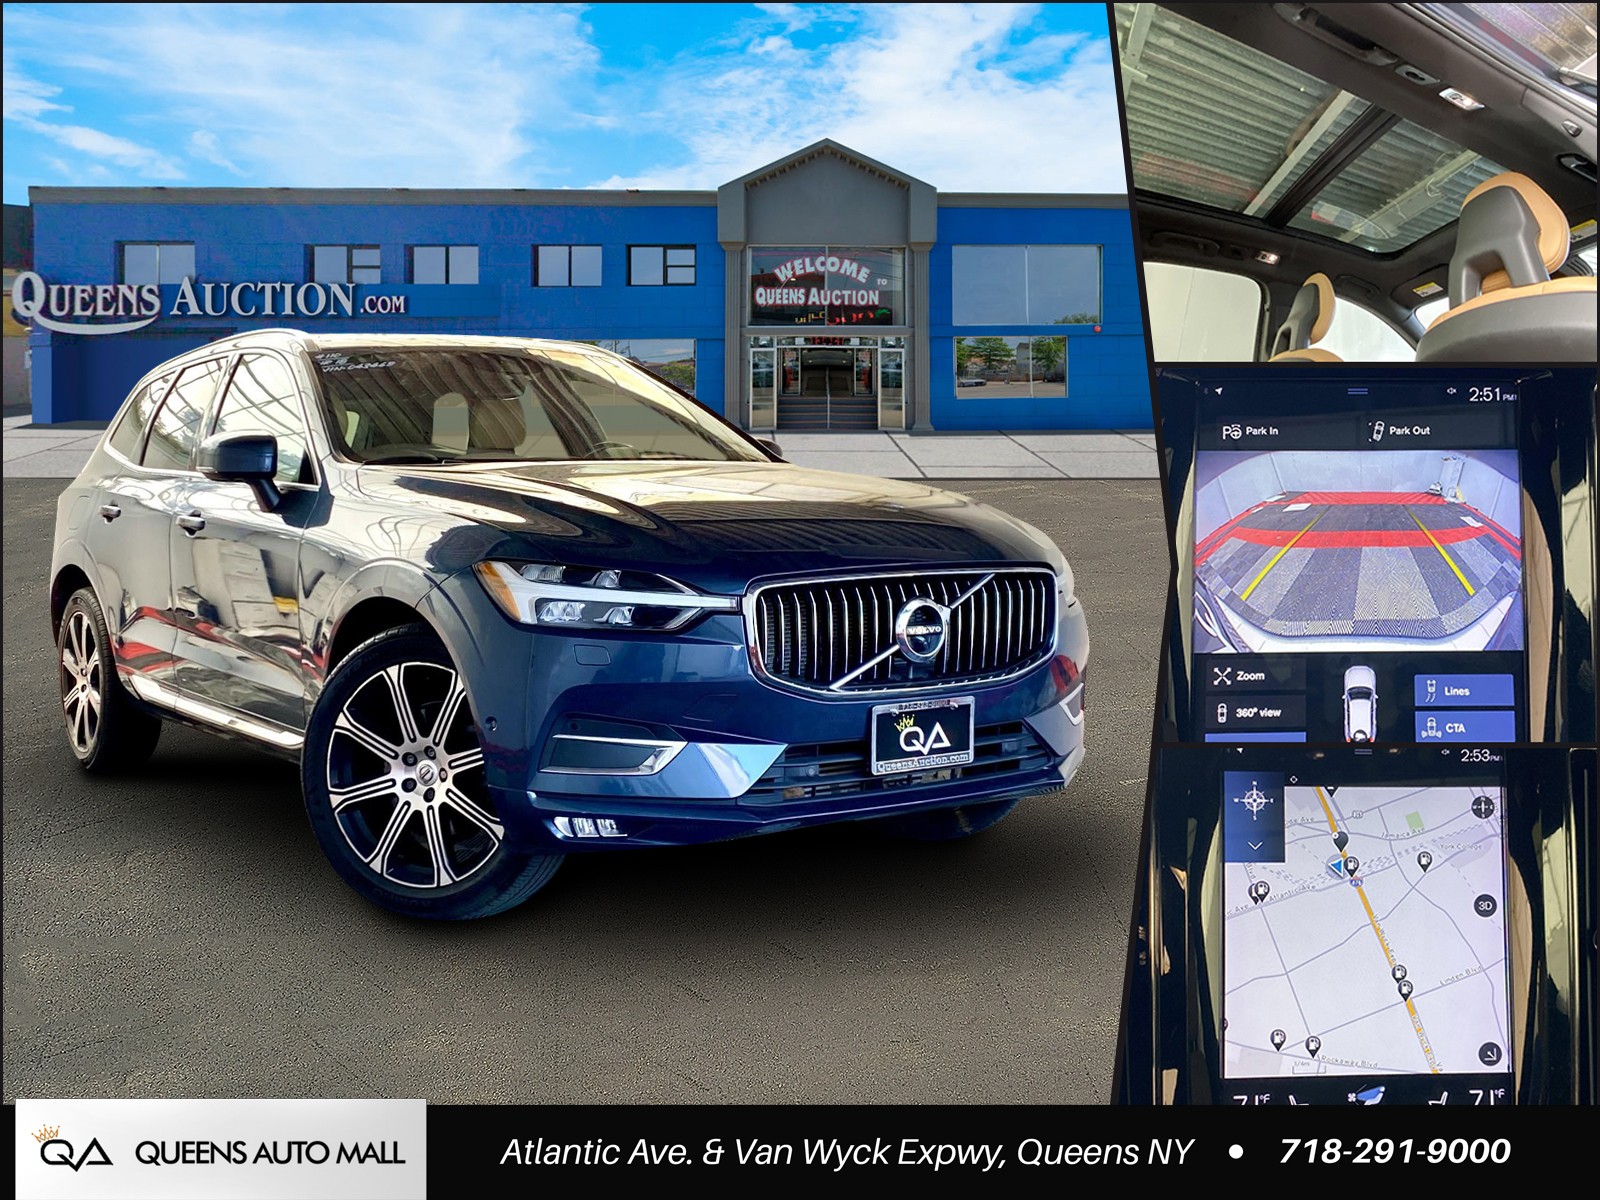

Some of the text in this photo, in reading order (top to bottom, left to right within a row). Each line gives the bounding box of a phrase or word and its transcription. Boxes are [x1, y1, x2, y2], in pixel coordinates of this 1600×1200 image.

[774, 256, 871, 283] WELCOME
[755, 287, 879, 307] QUEENS AUCTION
[12, 271, 161, 335] QUEENS
[170, 276, 356, 316] AUCTION
[1469, 387, 1500, 402] 2:51
[1246, 426, 1279, 436] Park In
[1389, 426, 1431, 436] Park Out
[907, 626, 942, 635] VOLVO
[1236, 671, 1265, 681] Zoom
[1444, 686, 1470, 697] Lines
[1259, 708, 1282, 718] view
[1445, 723, 1466, 734] CTA
[1461, 748, 1490, 762] 2:53
[877, 753, 969, 772] QueensAuction.com
[1478, 900, 1493, 911] 3D
